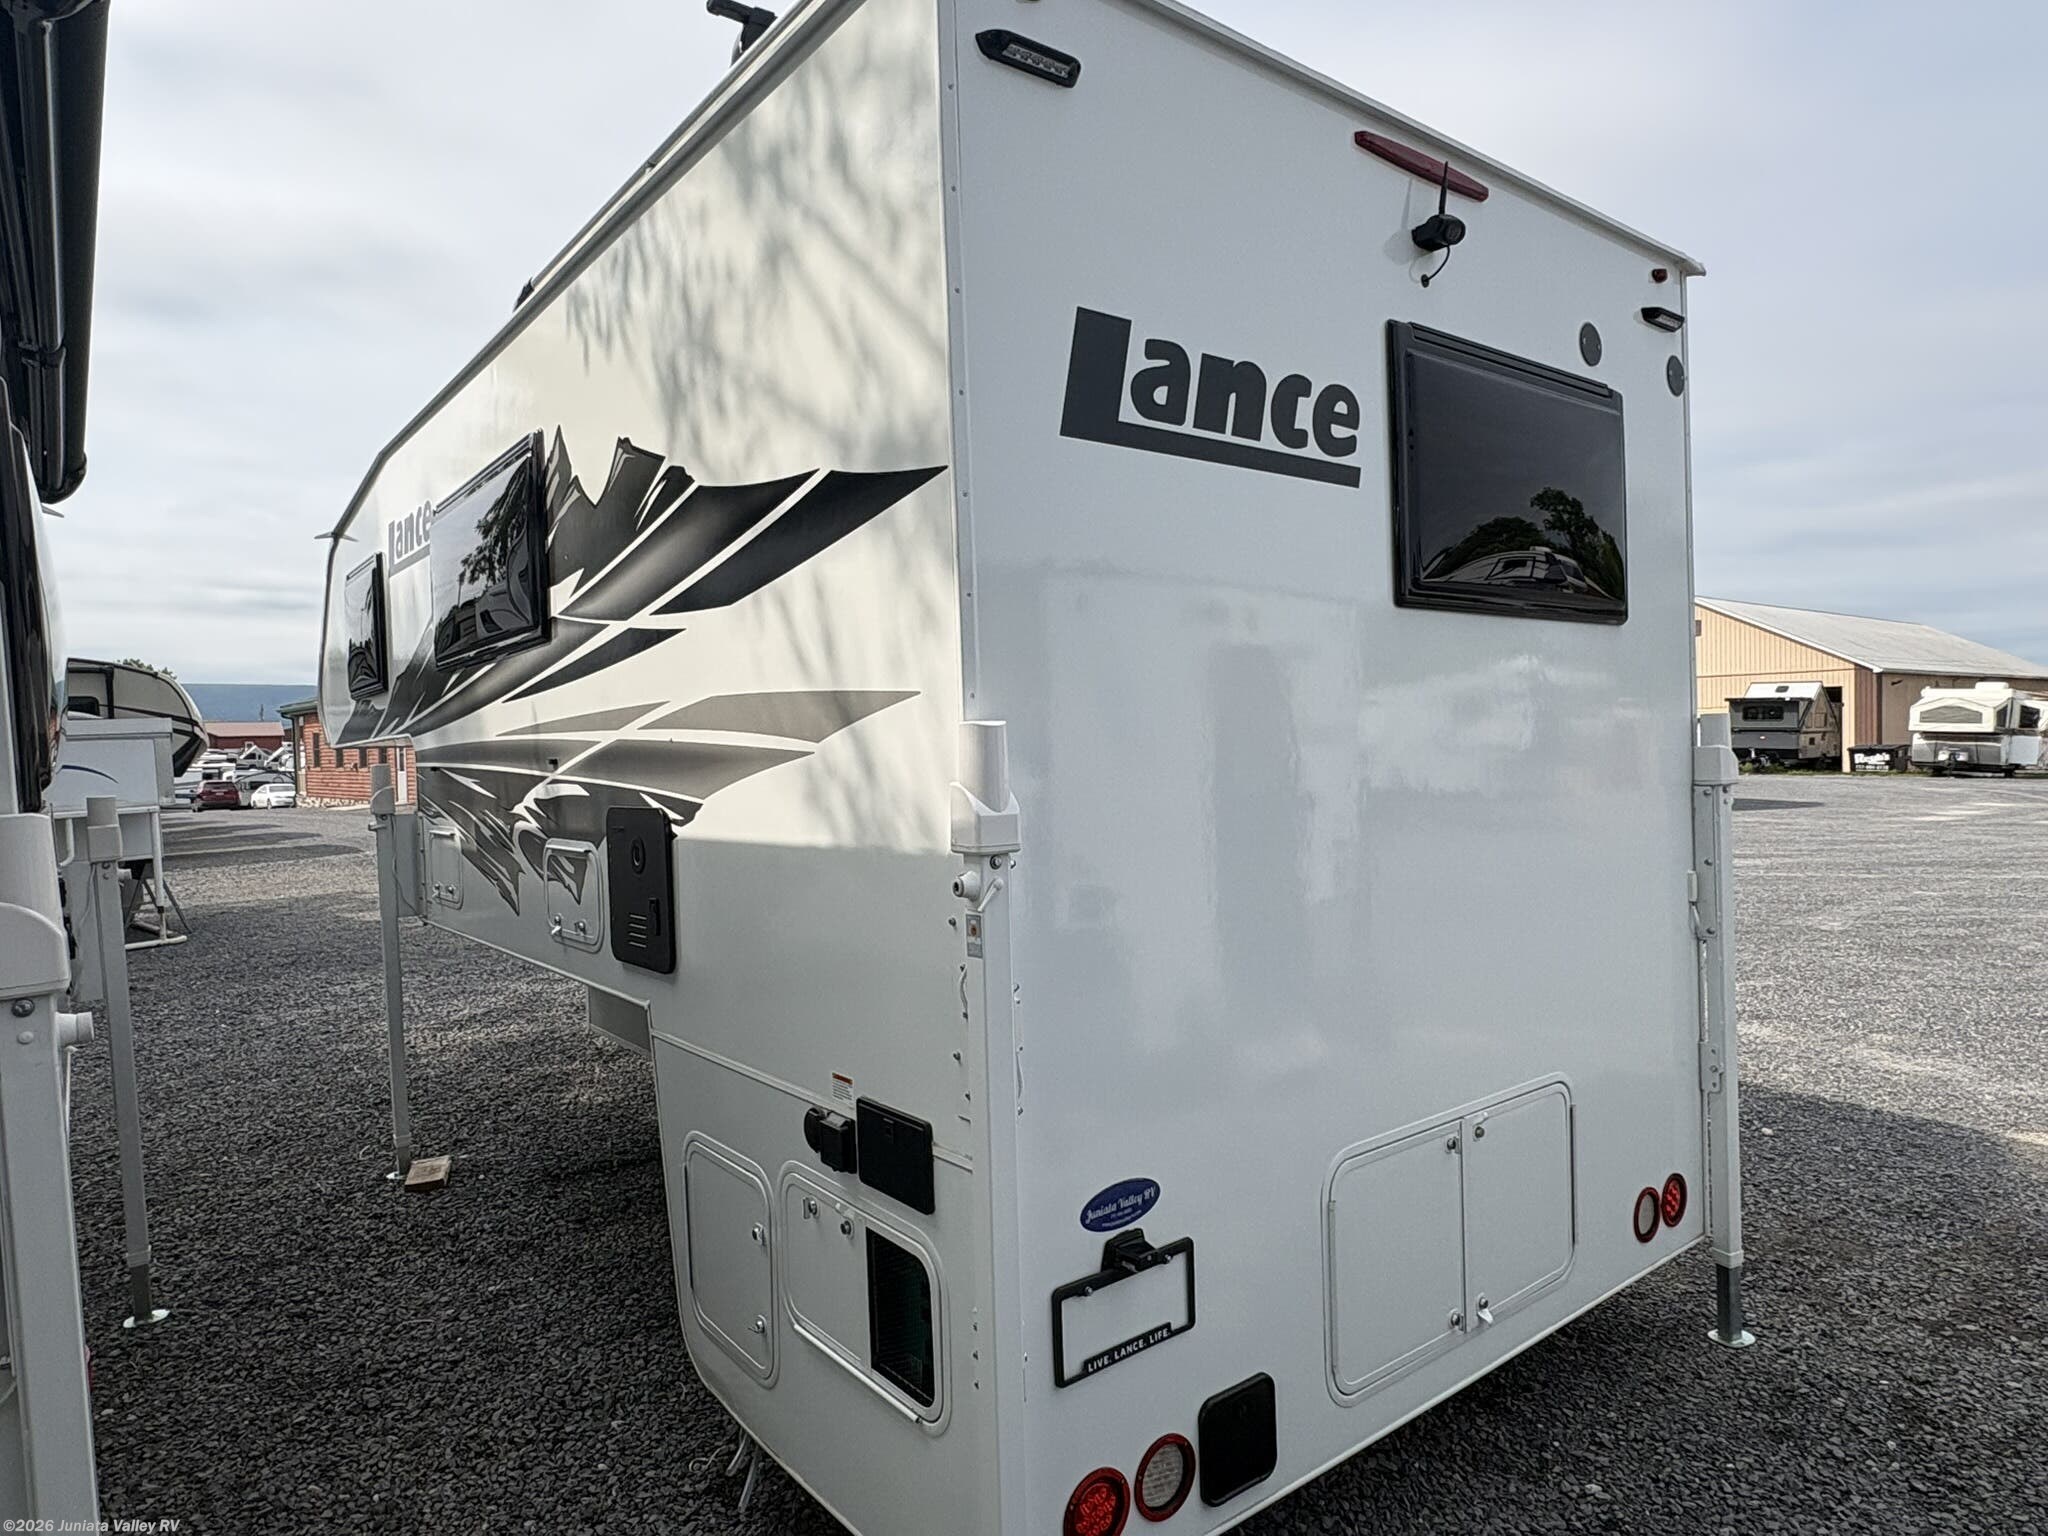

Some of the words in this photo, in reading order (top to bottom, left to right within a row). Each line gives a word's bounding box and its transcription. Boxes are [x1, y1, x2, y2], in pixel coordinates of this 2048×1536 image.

[1060, 306, 1361, 488] Lance
[388, 500, 431, 578] Lance
[1085, 1203, 1117, 1225] Juniata
[1117, 1194, 1143, 1208] Valley
[1143, 1185, 1156, 1200] RV
[1087, 1355, 1112, 1373] LIVE.
[1114, 1338, 1147, 1361] LANCE.
[1149, 1328, 1171, 1344] LIFE.
